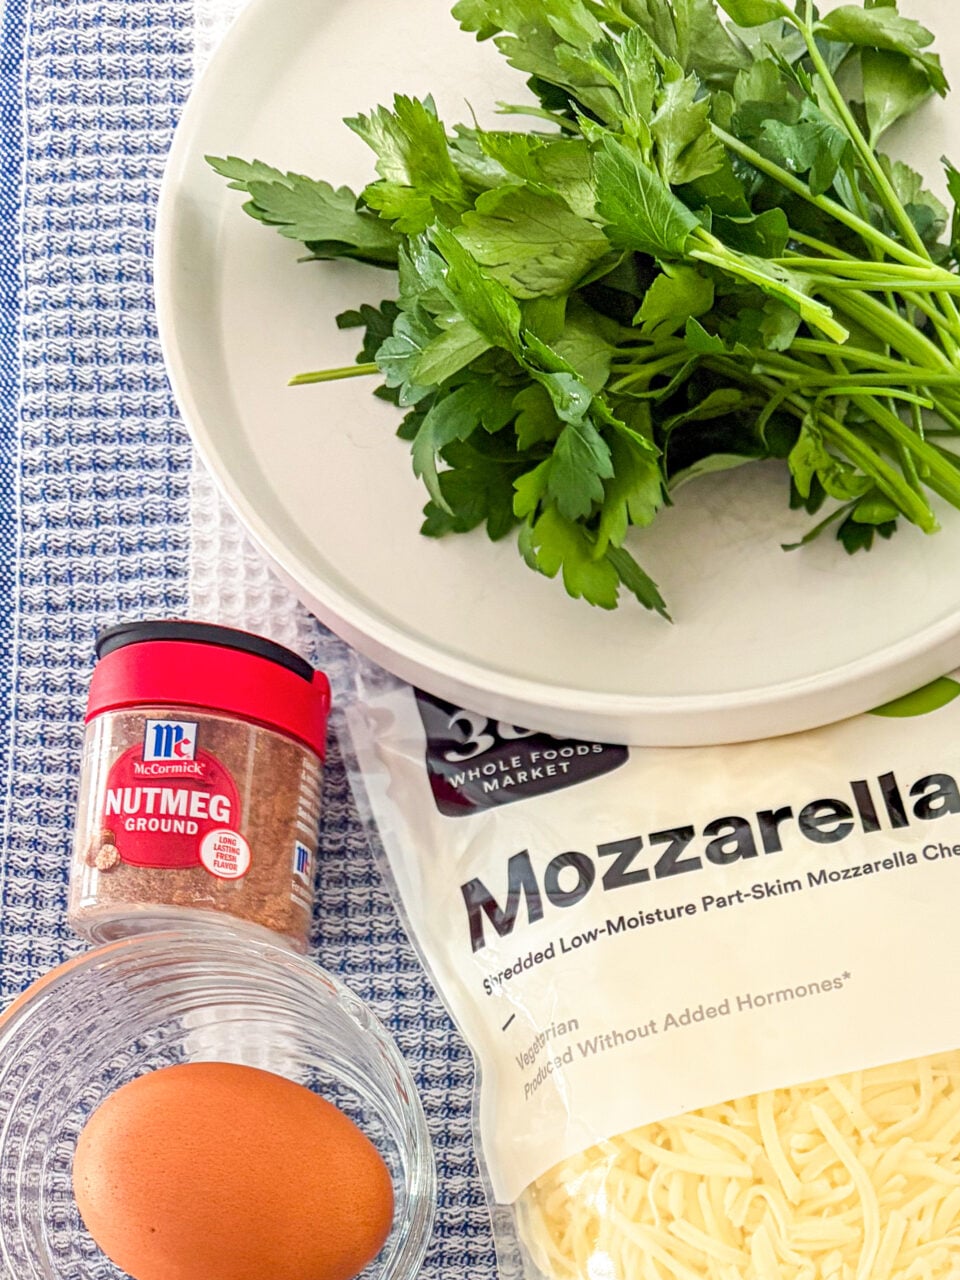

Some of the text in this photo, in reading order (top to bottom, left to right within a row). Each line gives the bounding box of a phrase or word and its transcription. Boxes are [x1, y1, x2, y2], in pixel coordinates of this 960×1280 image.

[134, 762, 205, 775] McCormick
[449, 744, 603, 789] WHOLE FOODS
[483, 762, 571, 793] MARKET
[105, 787, 231, 823] NUTMEG
[125, 818, 198, 835] GROUND
[214, 844, 240, 855] LASTING
[219, 836, 237, 846] LONG
[213, 860, 238, 871] FLAVOR
[216, 852, 237, 863] FRESH
[559, 900, 697, 954] Low-Moisture
[700, 876, 802, 914] Part-Skim
[806, 848, 918, 888] Mozzarella
[515, 1018, 579, 1072] Vegetarian
[524, 1046, 574, 1100] Produced
[577, 1016, 658, 1060] Without
[662, 998, 731, 1032] Added
